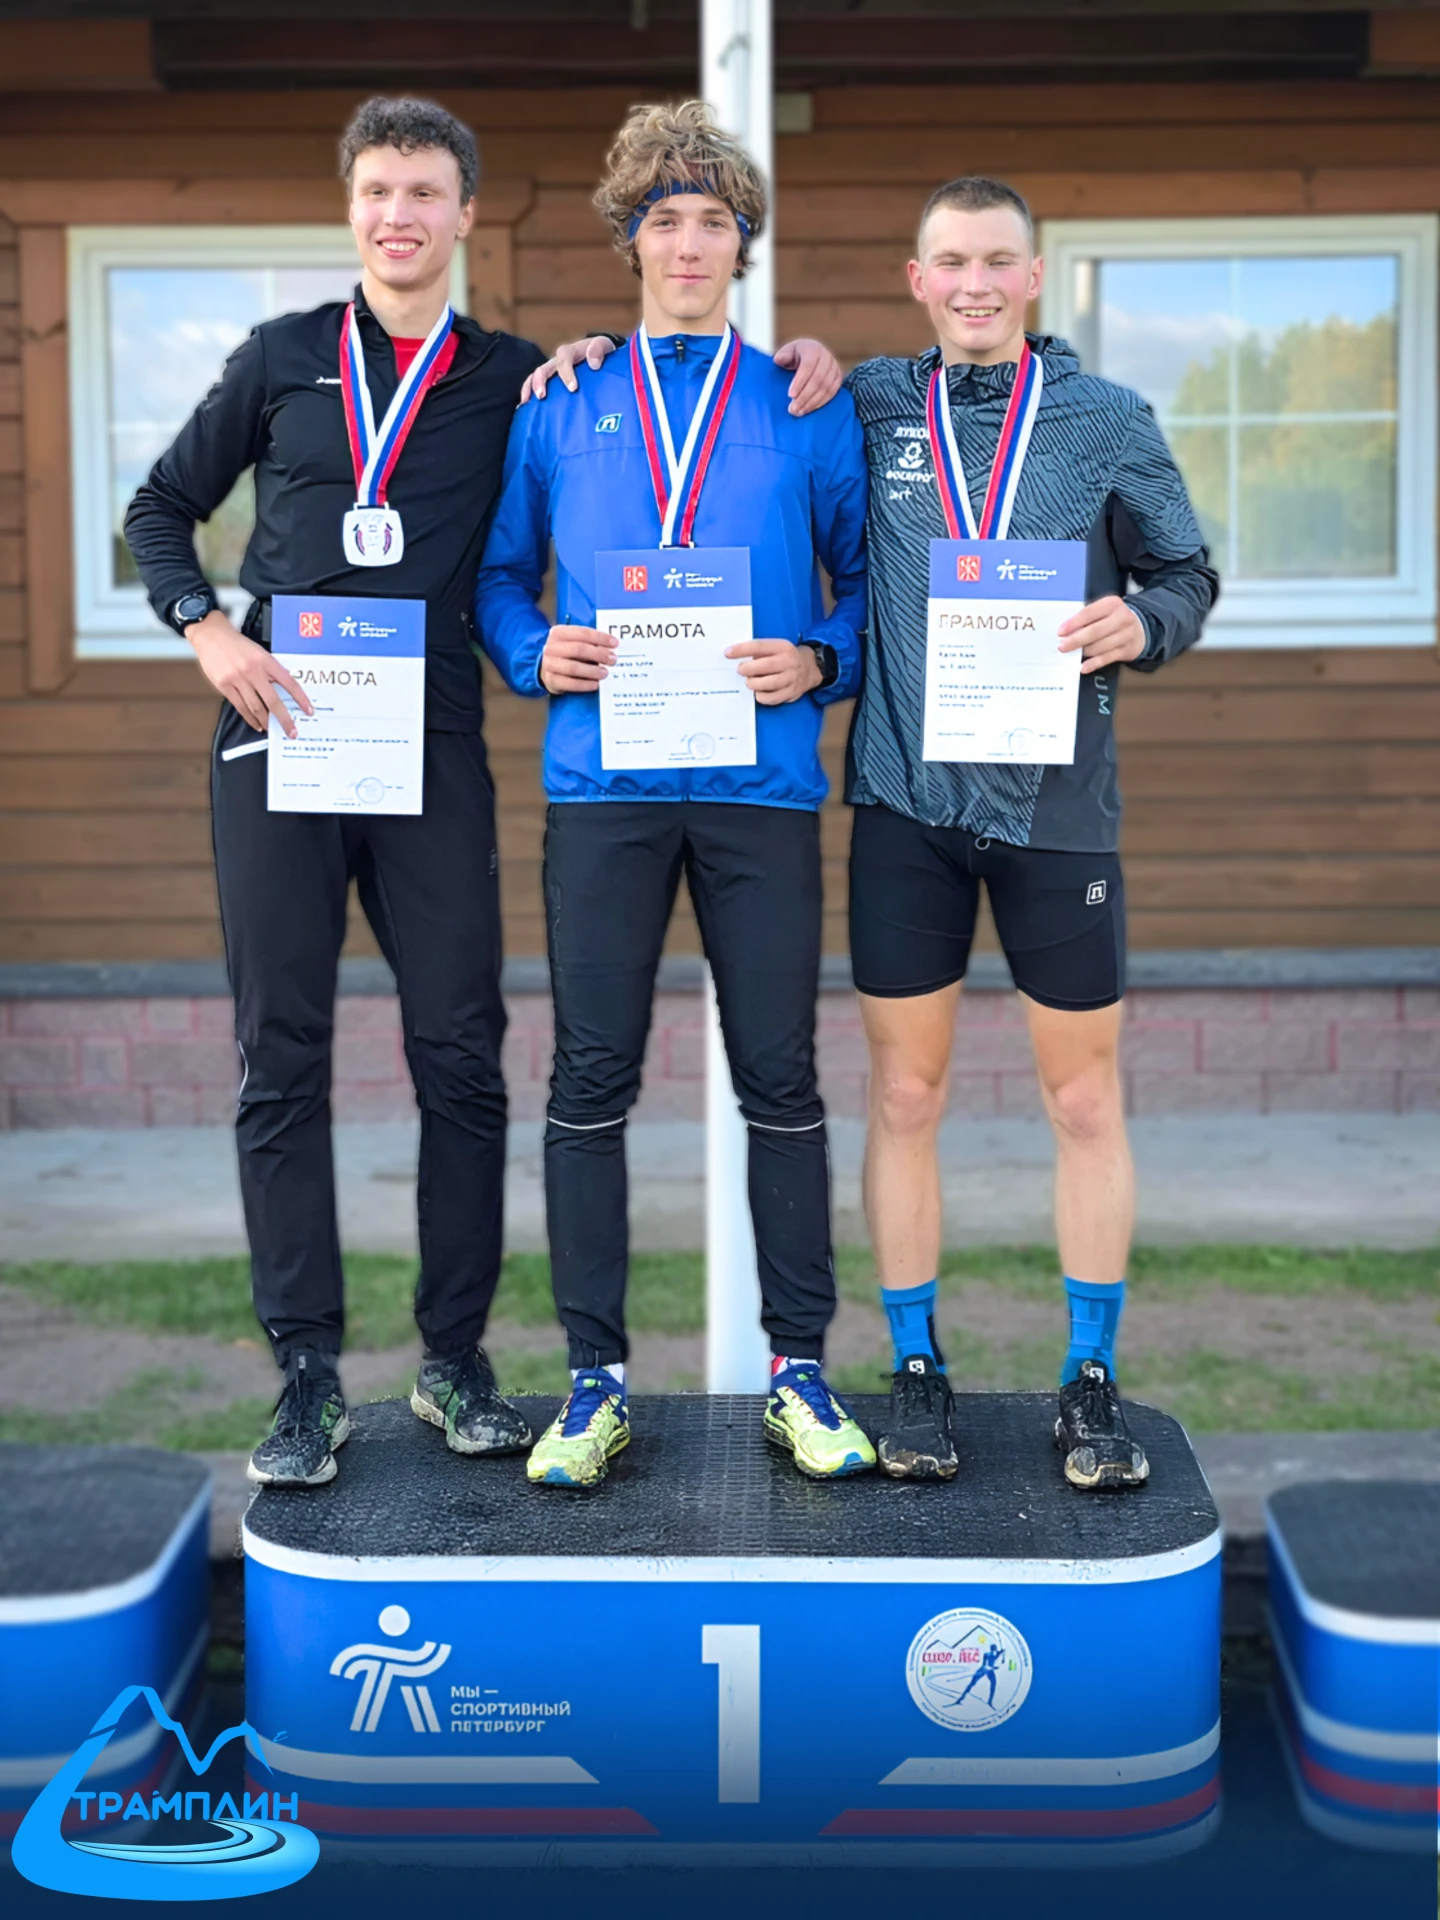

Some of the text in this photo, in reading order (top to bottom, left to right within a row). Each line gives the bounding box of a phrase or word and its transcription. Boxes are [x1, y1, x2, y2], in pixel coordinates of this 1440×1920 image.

[939, 614, 1036, 631] ГРАМОТА
[608, 623, 706, 639] ГРАМОТА
[288, 670, 377, 686] РАМОТА
[450, 1685, 480, 1699] МЫ
[450, 1701, 571, 1716] СПОРТИВНЫЙ
[702, 1624, 761, 1804] 1
[450, 1719, 547, 1734] ПЕТЕРБУРГ
